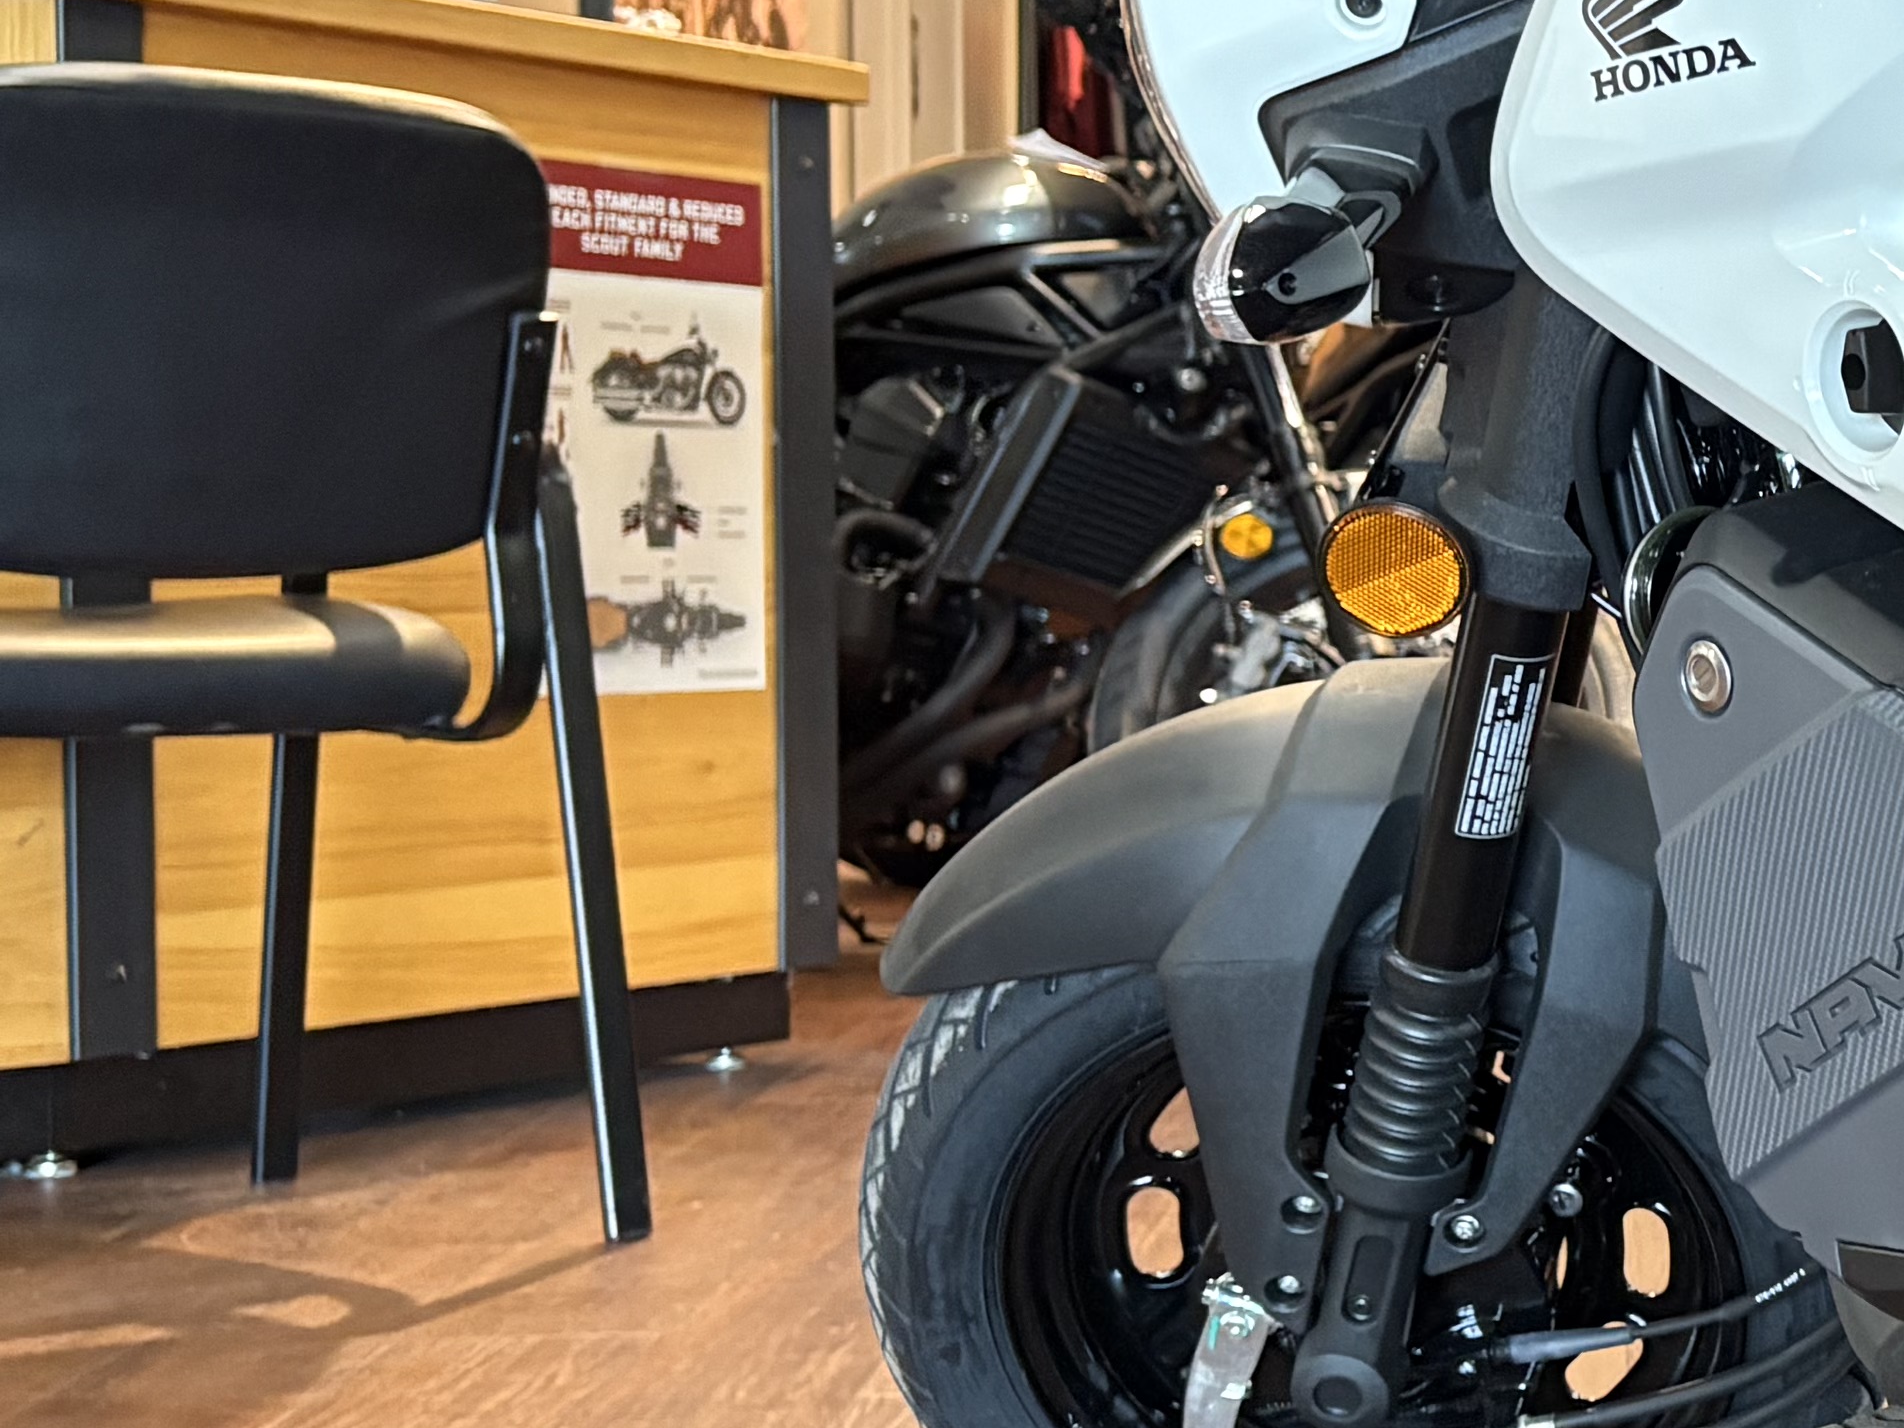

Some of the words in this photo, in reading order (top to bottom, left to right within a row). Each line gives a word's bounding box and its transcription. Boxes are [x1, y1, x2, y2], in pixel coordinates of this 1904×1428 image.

[1590, 37, 1757, 102] HONDA
[594, 188, 667, 217] STANDARD
[668, 197, 681, 219] &
[682, 199, 746, 227] REDUCED
[580, 231, 630, 257] SCOUT
[633, 236, 684, 261] FAMILY
[594, 212, 656, 237] FITMENT
[659, 218, 690, 242] FOR
[692, 221, 721, 245] THE
